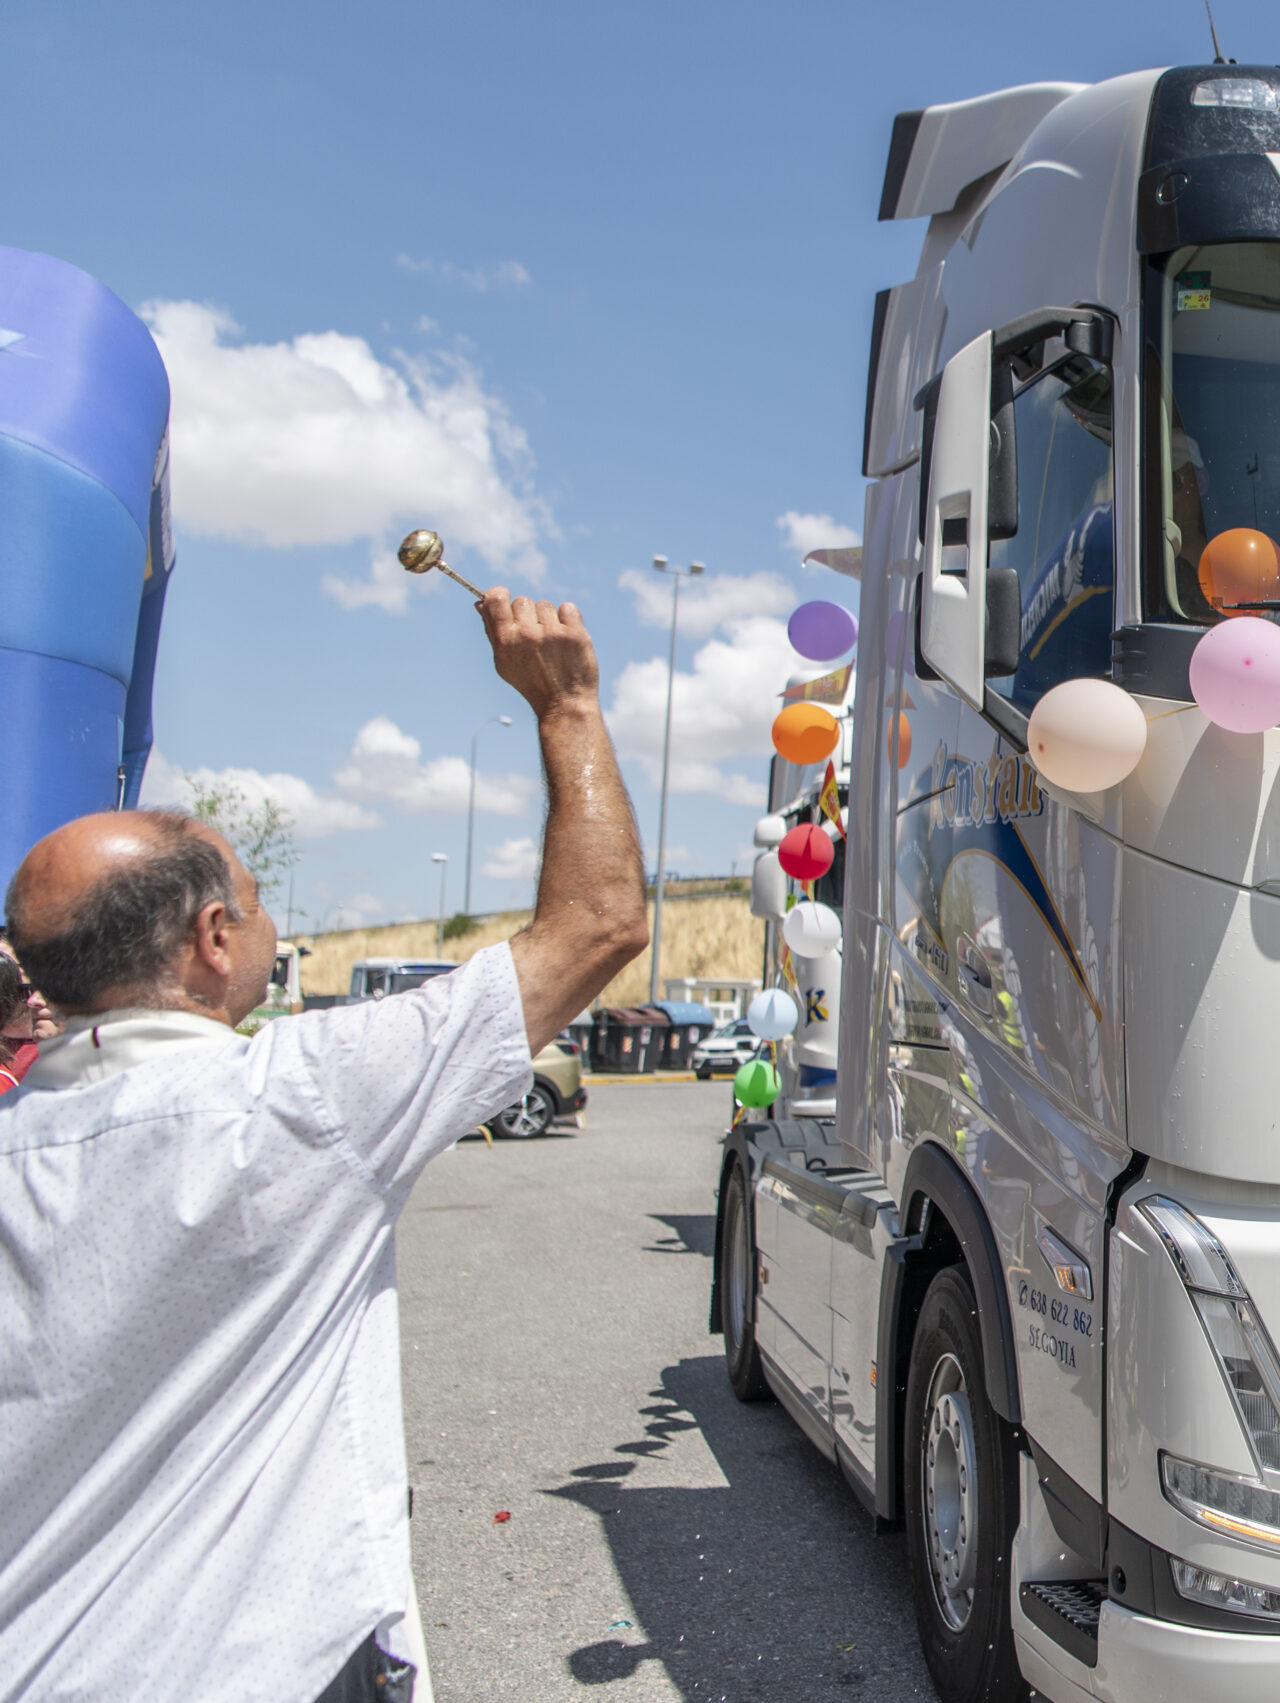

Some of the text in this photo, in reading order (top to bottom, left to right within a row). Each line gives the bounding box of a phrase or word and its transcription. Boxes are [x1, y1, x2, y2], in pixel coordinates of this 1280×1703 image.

[1031, 1289, 1093, 1337] 638 622 862
